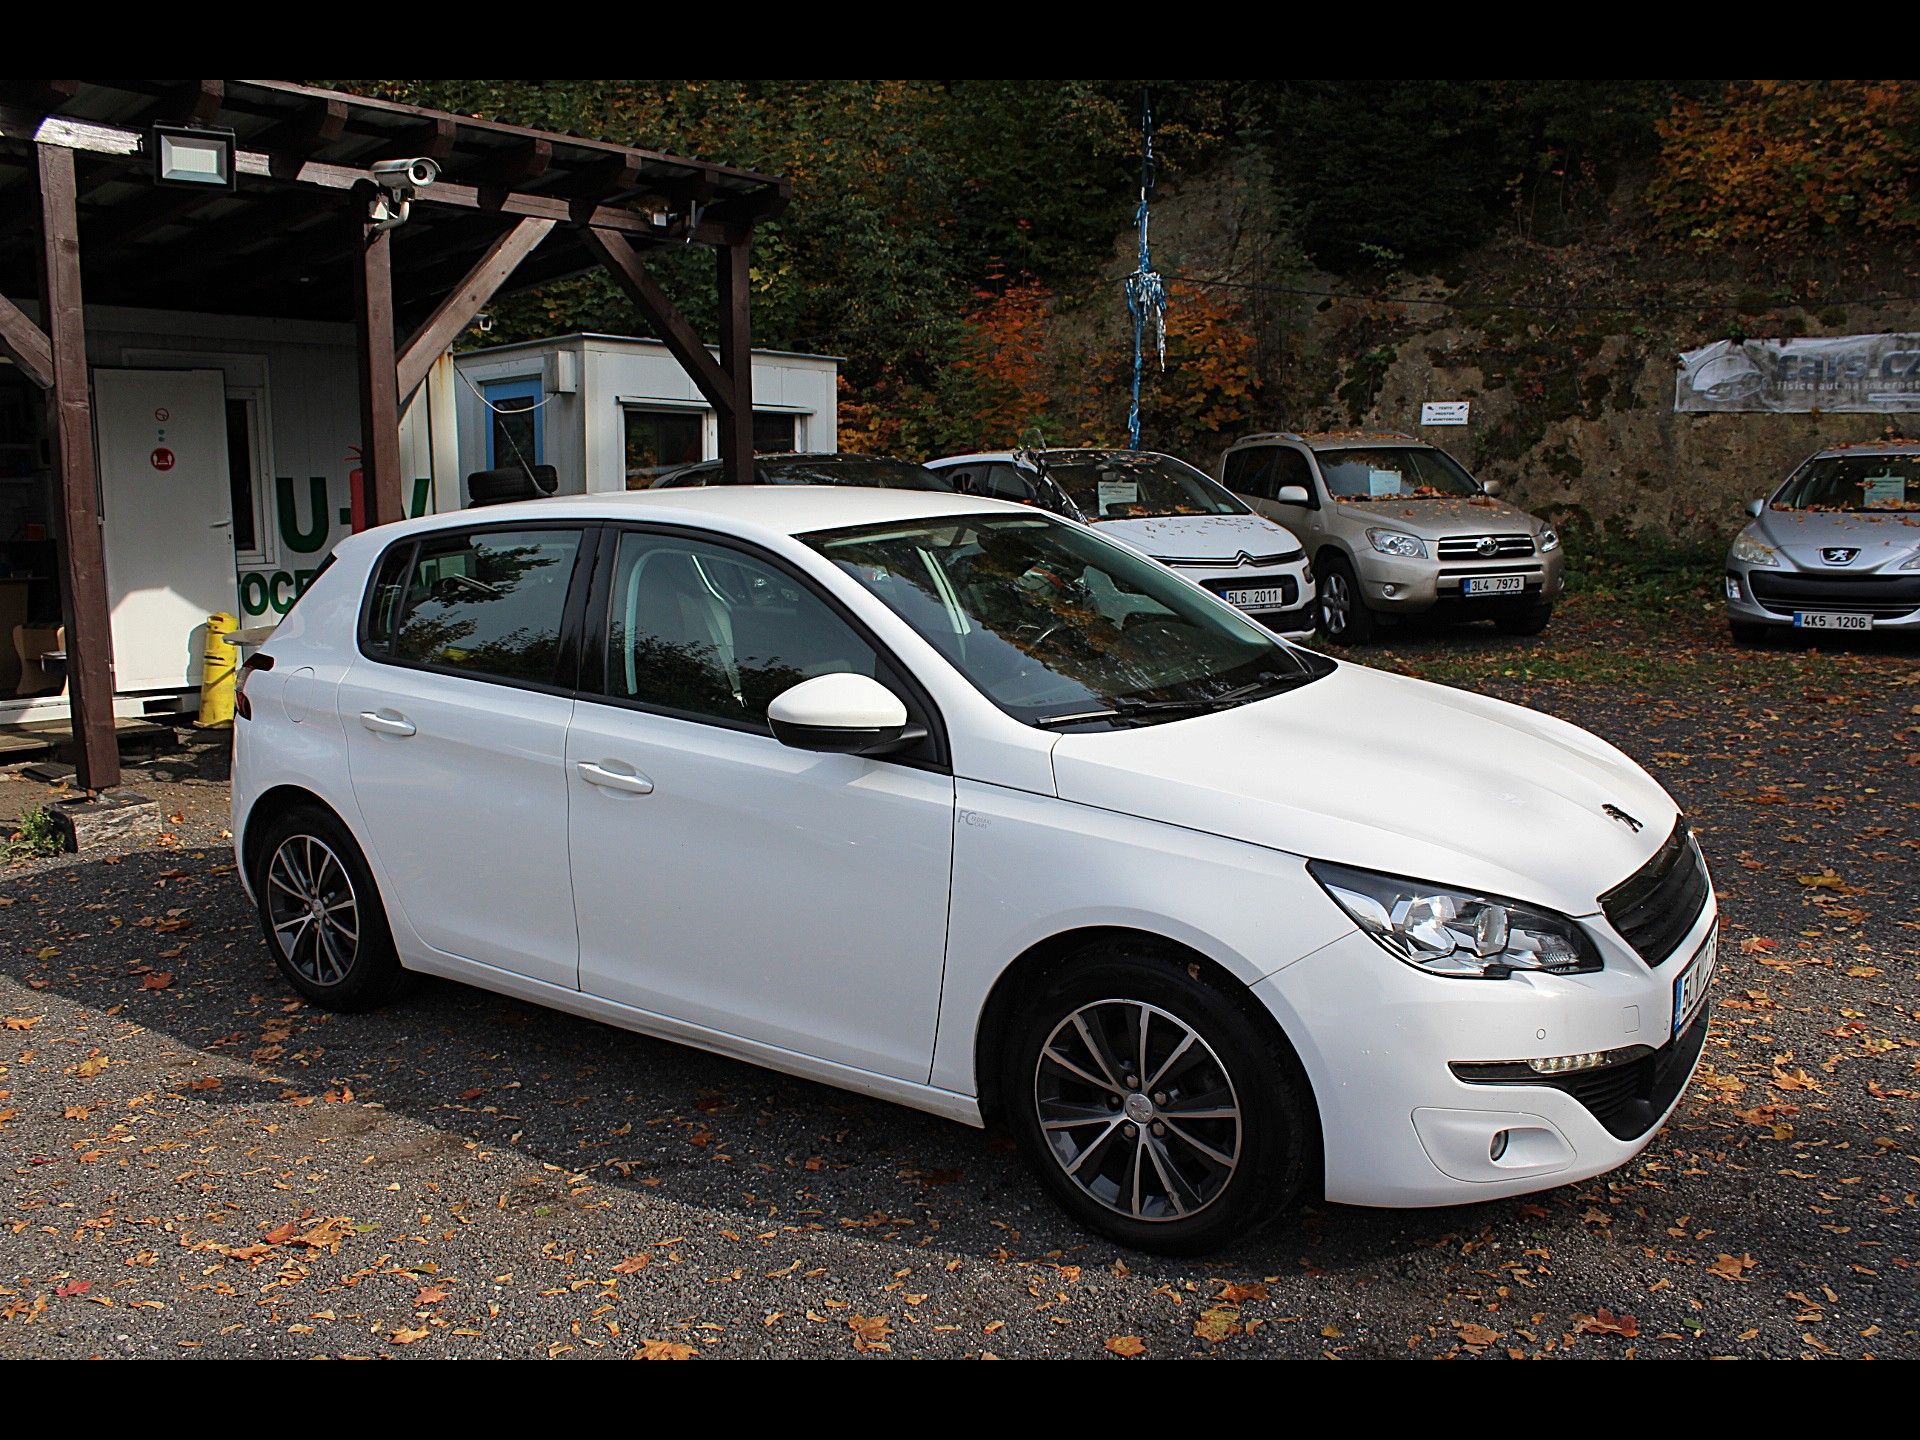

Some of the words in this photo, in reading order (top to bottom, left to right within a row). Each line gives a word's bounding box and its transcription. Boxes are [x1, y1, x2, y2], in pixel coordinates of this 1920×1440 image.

[1471, 579, 1489, 591] 3L4
[1496, 578, 1520, 590] 7973
[1228, 591, 1247, 605] 5L6
[1254, 589, 1278, 603] 2011
[1803, 614, 1826, 627] 4K5
[1836, 616, 1866, 629] 1206
